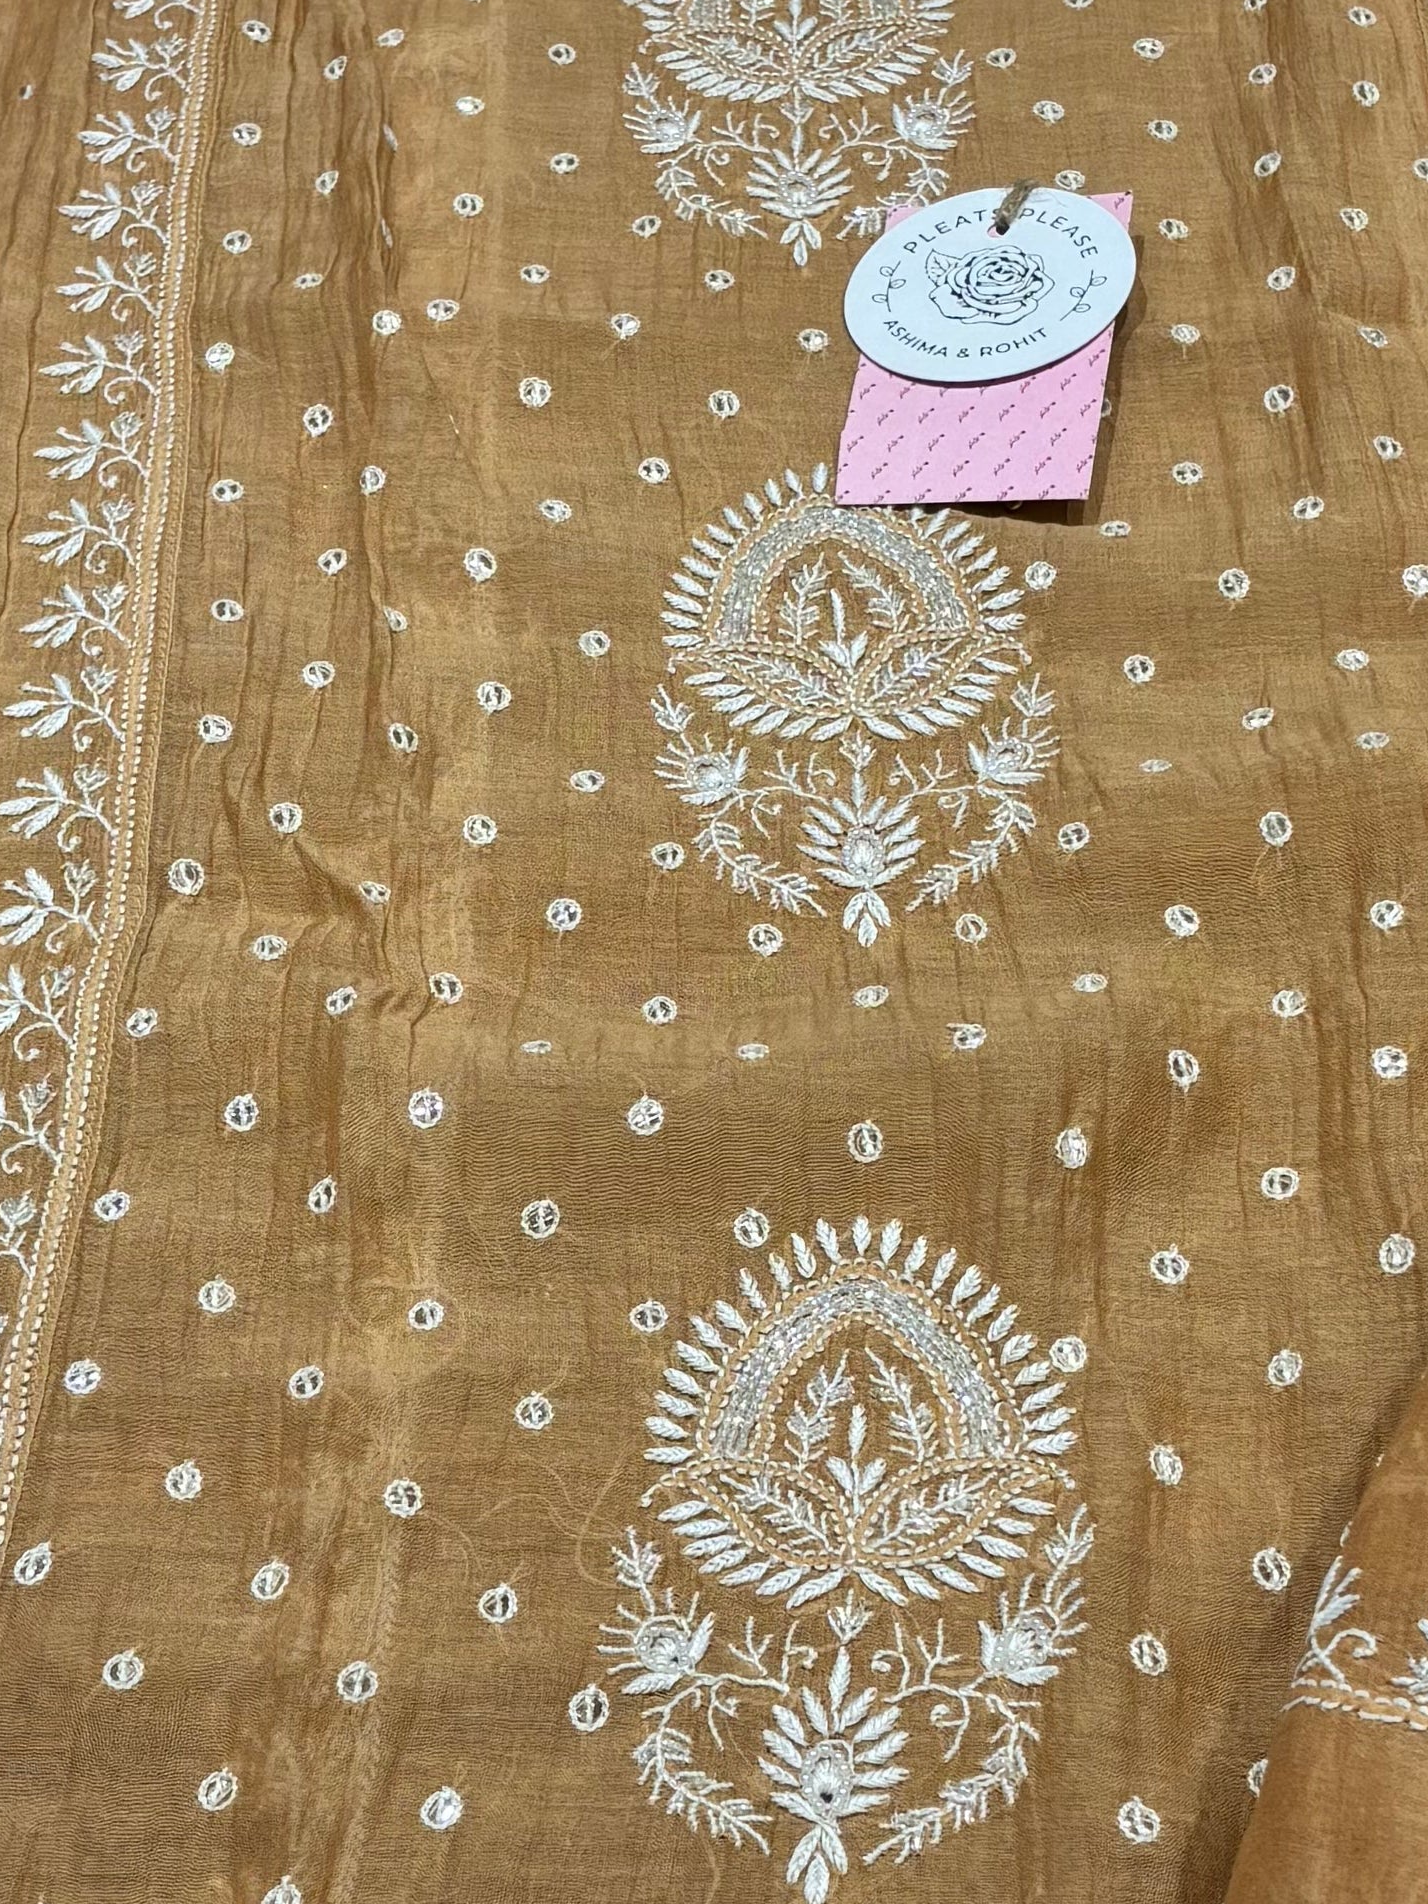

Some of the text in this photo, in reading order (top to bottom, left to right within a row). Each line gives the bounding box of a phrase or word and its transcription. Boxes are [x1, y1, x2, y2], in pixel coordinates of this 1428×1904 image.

[1019, 207, 1099, 259] PLEASE
[883, 319, 1048, 359] ASHIMA & ROHIT
